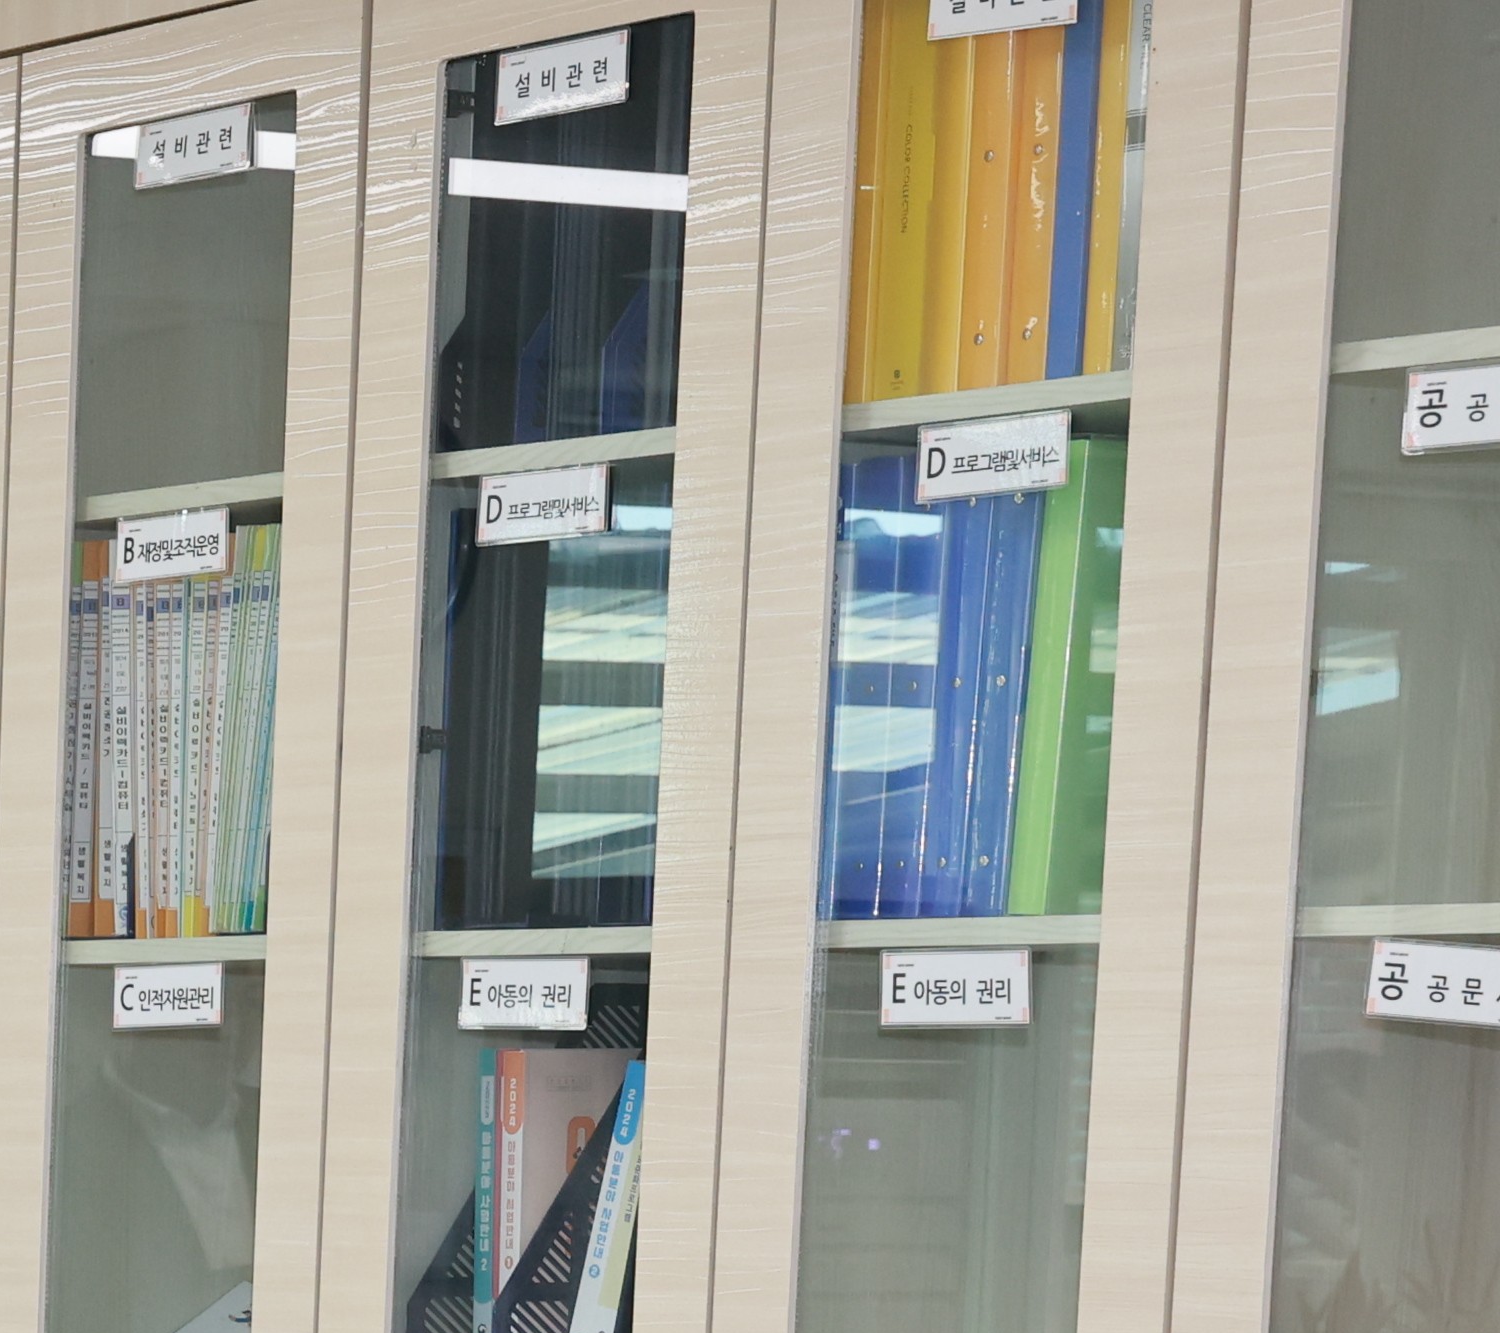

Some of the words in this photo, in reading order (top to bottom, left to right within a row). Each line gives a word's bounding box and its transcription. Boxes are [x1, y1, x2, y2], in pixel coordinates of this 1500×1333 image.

[1141, 3, 1152, 42] CLEAR
[1416, 388, 1449, 429] 공
[927, 447, 946, 479] D
[486, 495, 503, 524] D
[124, 537, 135, 564] B
[137, 533, 220, 563] 재정및조직운영
[120, 984, 134, 1011] C
[138, 986, 213, 1012] 인적자원관리
[470, 978, 483, 1007] E
[487, 984, 534, 1008] 아동의
[541, 983, 572, 1008] 권리
[892, 973, 906, 1003] E
[913, 978, 967, 1006] 아동의
[975, 977, 1012, 1004] 권리
[1378, 962, 1409, 1001] 공
[508, 1077, 517, 1128] 2024
[619, 1087, 636, 1139] 2024
